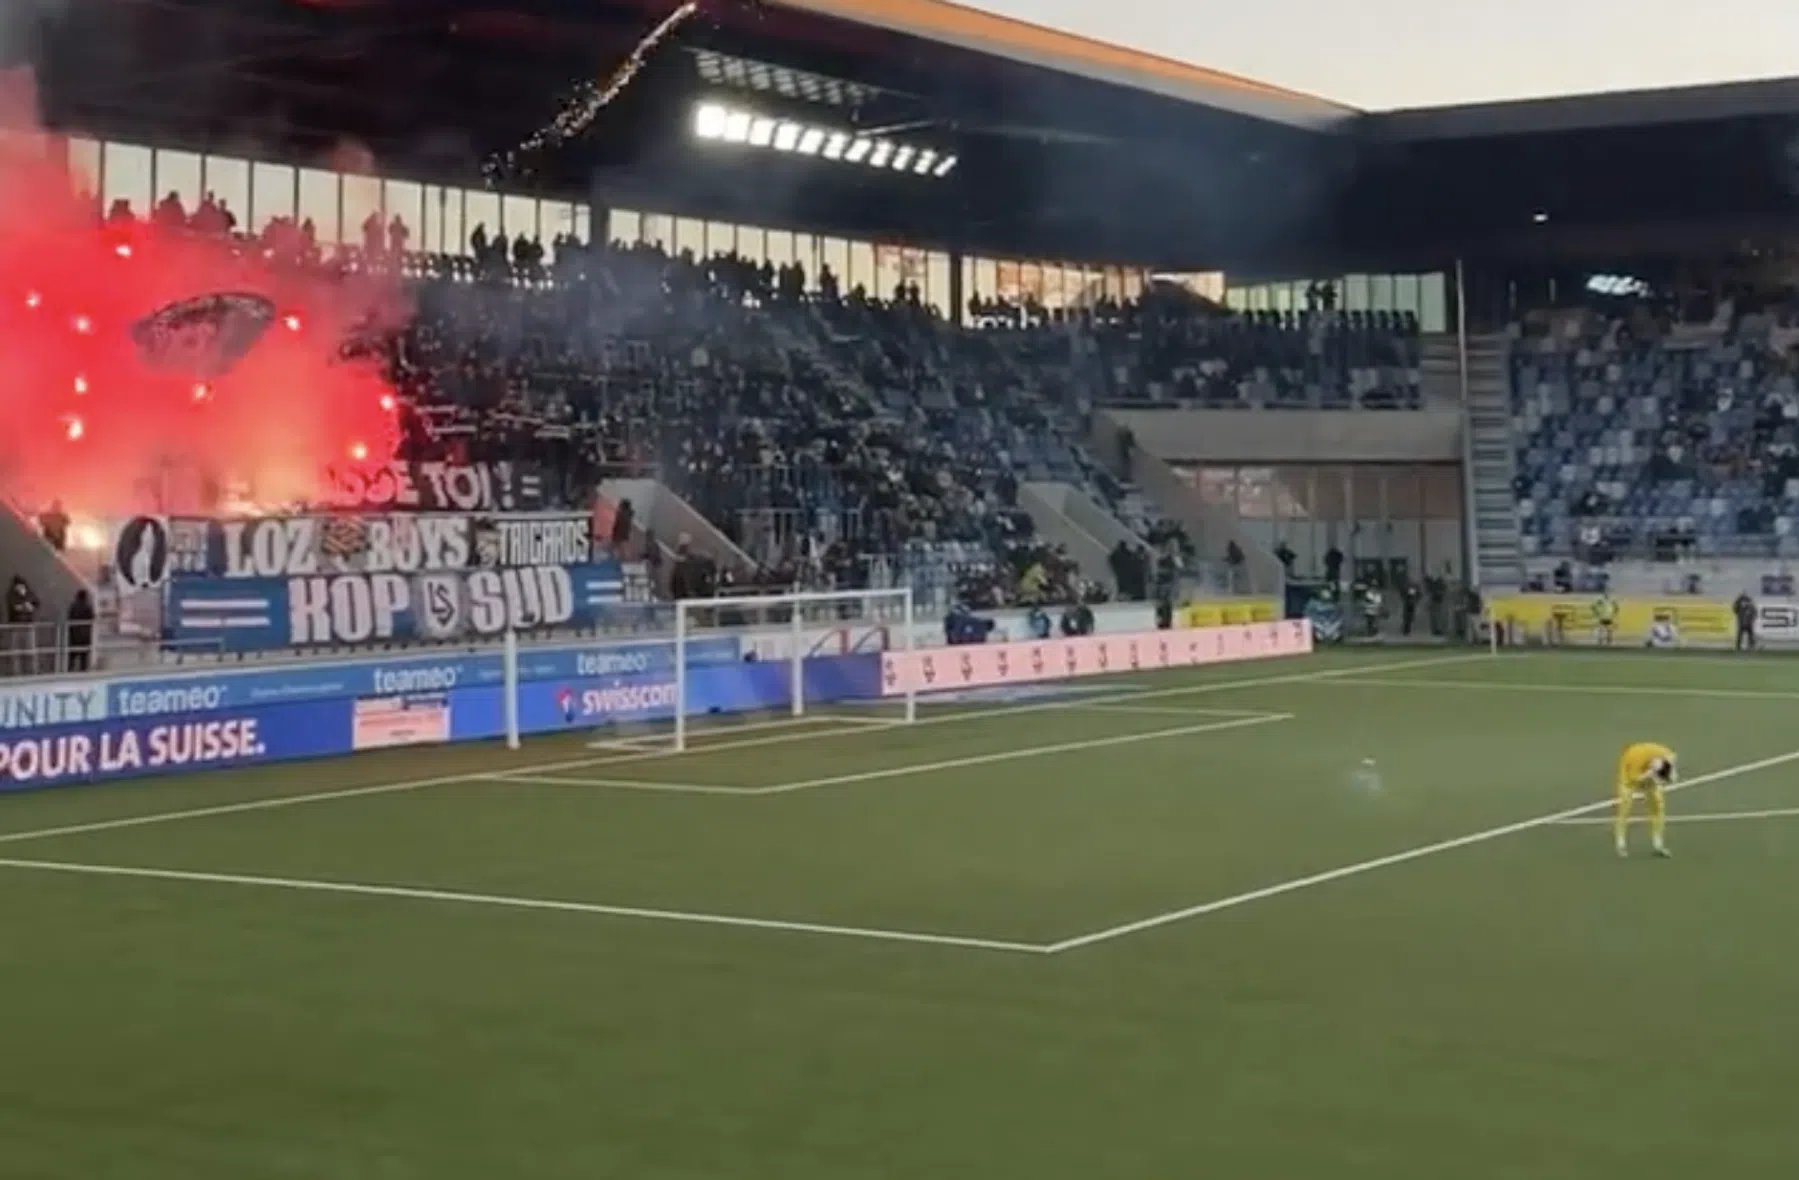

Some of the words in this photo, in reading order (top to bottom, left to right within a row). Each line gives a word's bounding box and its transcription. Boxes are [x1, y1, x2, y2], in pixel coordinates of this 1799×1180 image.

[220, 518, 315, 577] LOZ
[366, 513, 470, 572] BOYS
[288, 574, 410, 643] KOP
[468, 567, 574, 633] SUD
[100, 729, 141, 770] LA
[149, 719, 266, 766] SUISSE.
